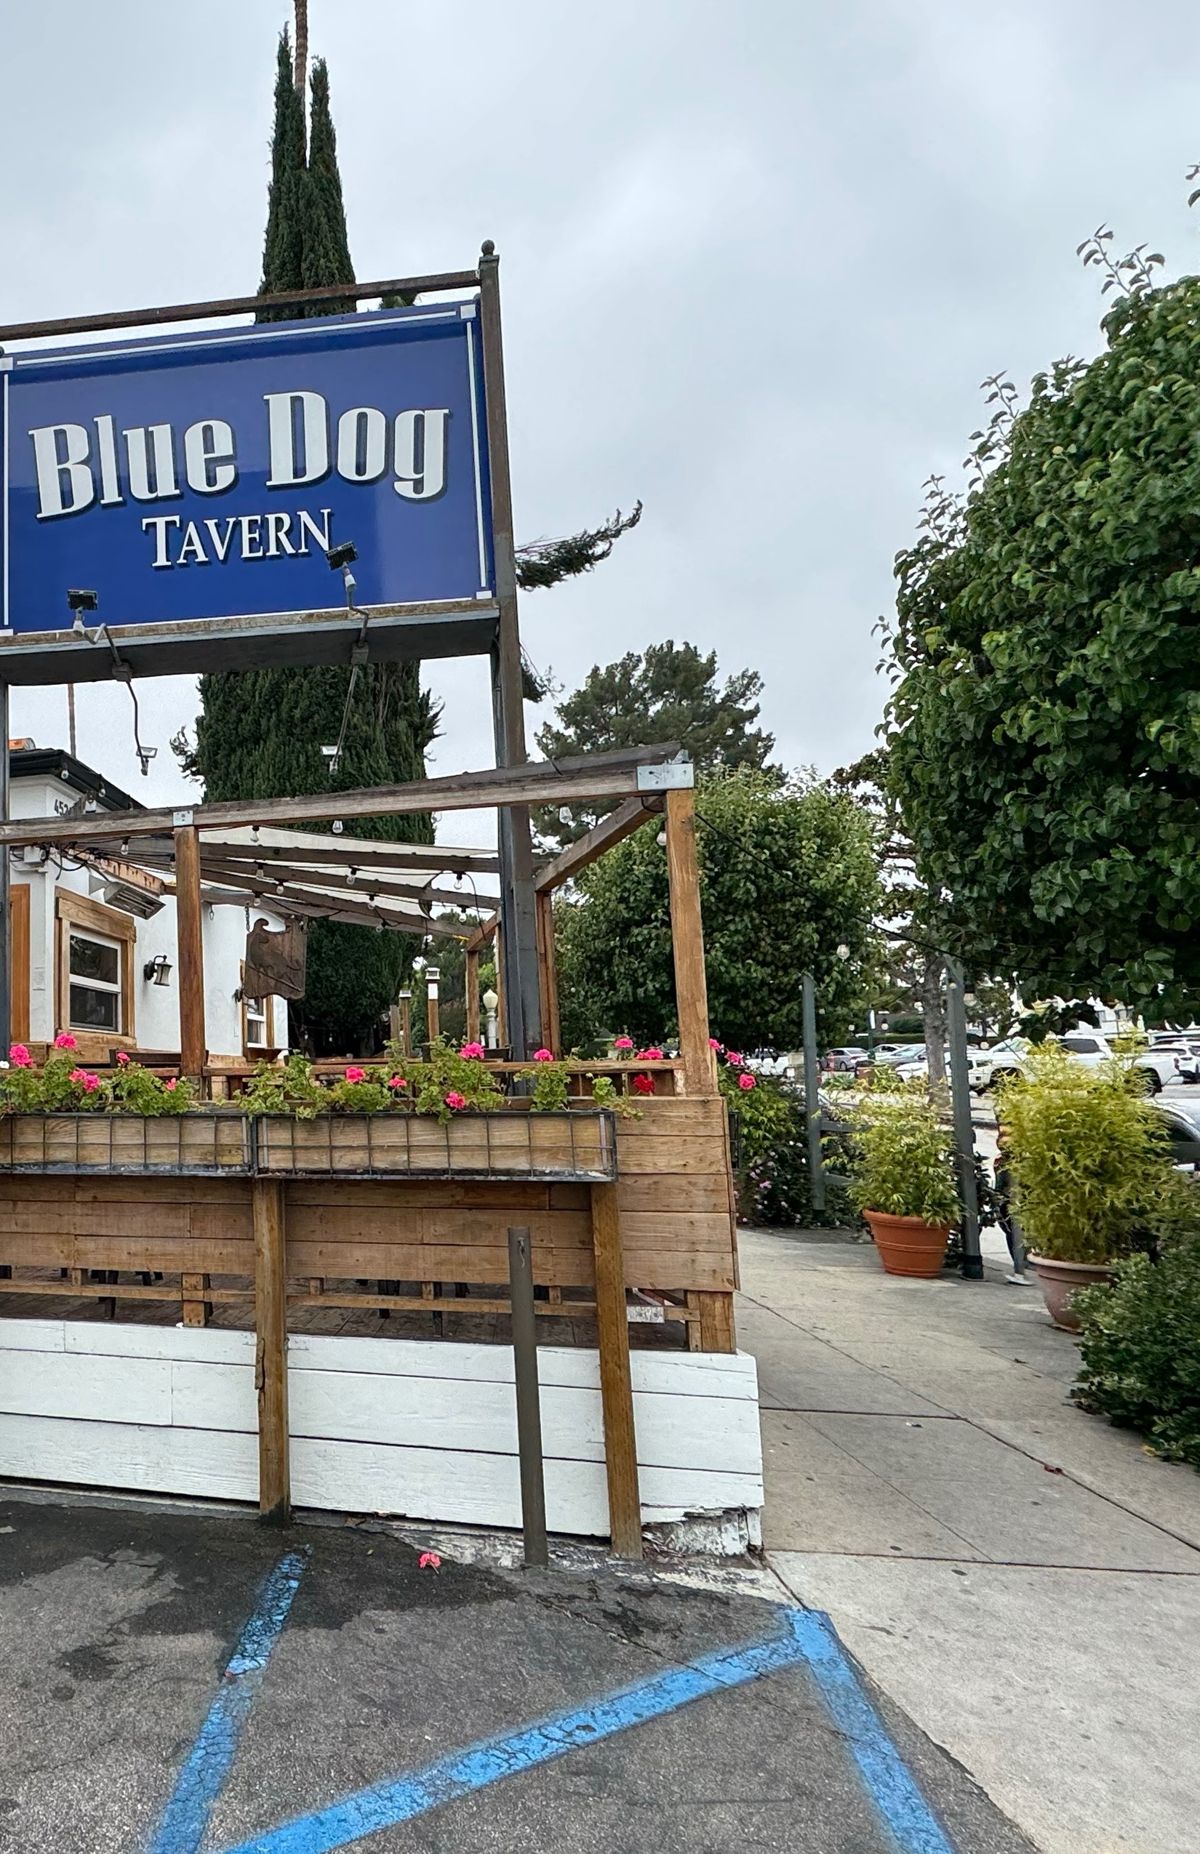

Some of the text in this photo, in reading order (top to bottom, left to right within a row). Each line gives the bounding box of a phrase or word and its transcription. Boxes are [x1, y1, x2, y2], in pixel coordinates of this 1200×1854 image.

[28, 391, 450, 518] Blue Dog
[141, 508, 332, 567] TAVERN
